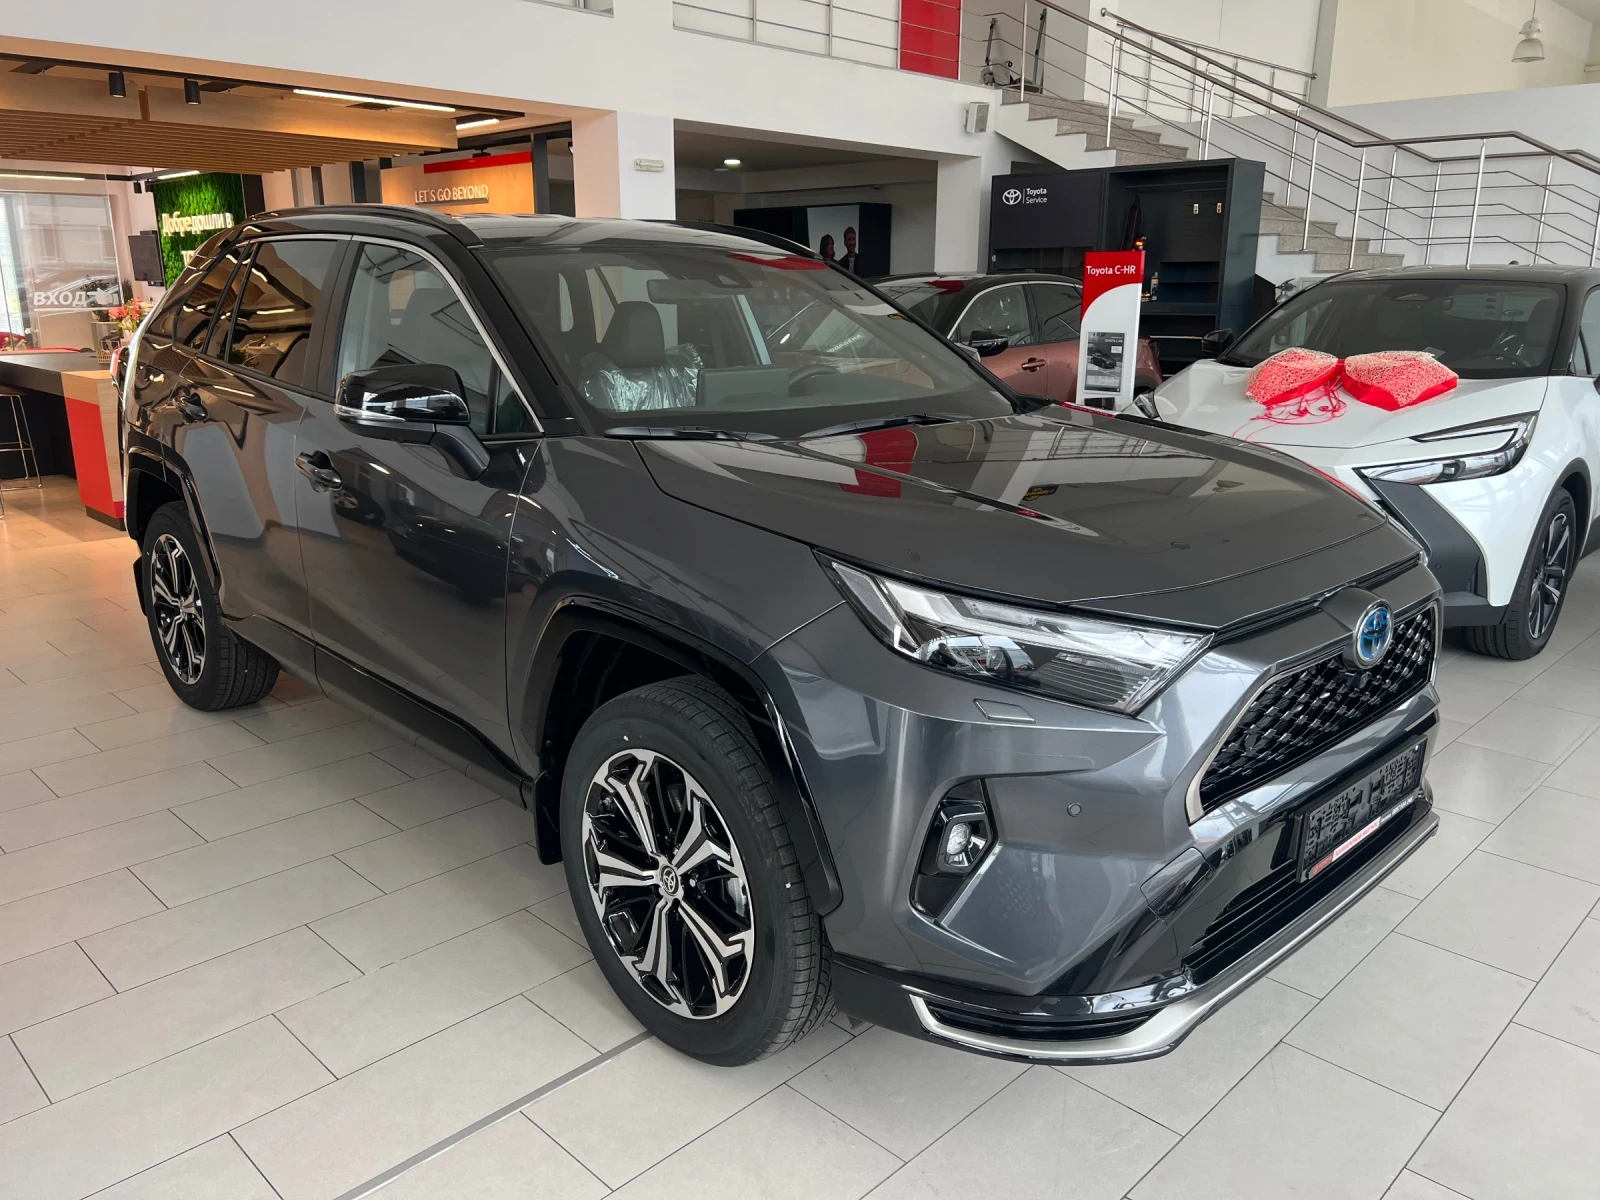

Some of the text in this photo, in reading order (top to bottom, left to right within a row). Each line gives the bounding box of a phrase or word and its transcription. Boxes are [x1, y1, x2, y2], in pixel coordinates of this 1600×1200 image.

[437, 188, 451, 202] GO
[1026, 188, 1047, 197] Toyota
[1026, 196, 1048, 204] Service
[162, 211, 224, 237] Добредошли
[1086, 264, 1136, 277] Toyota C-HR
[33, 291, 88, 308] ВХОД
